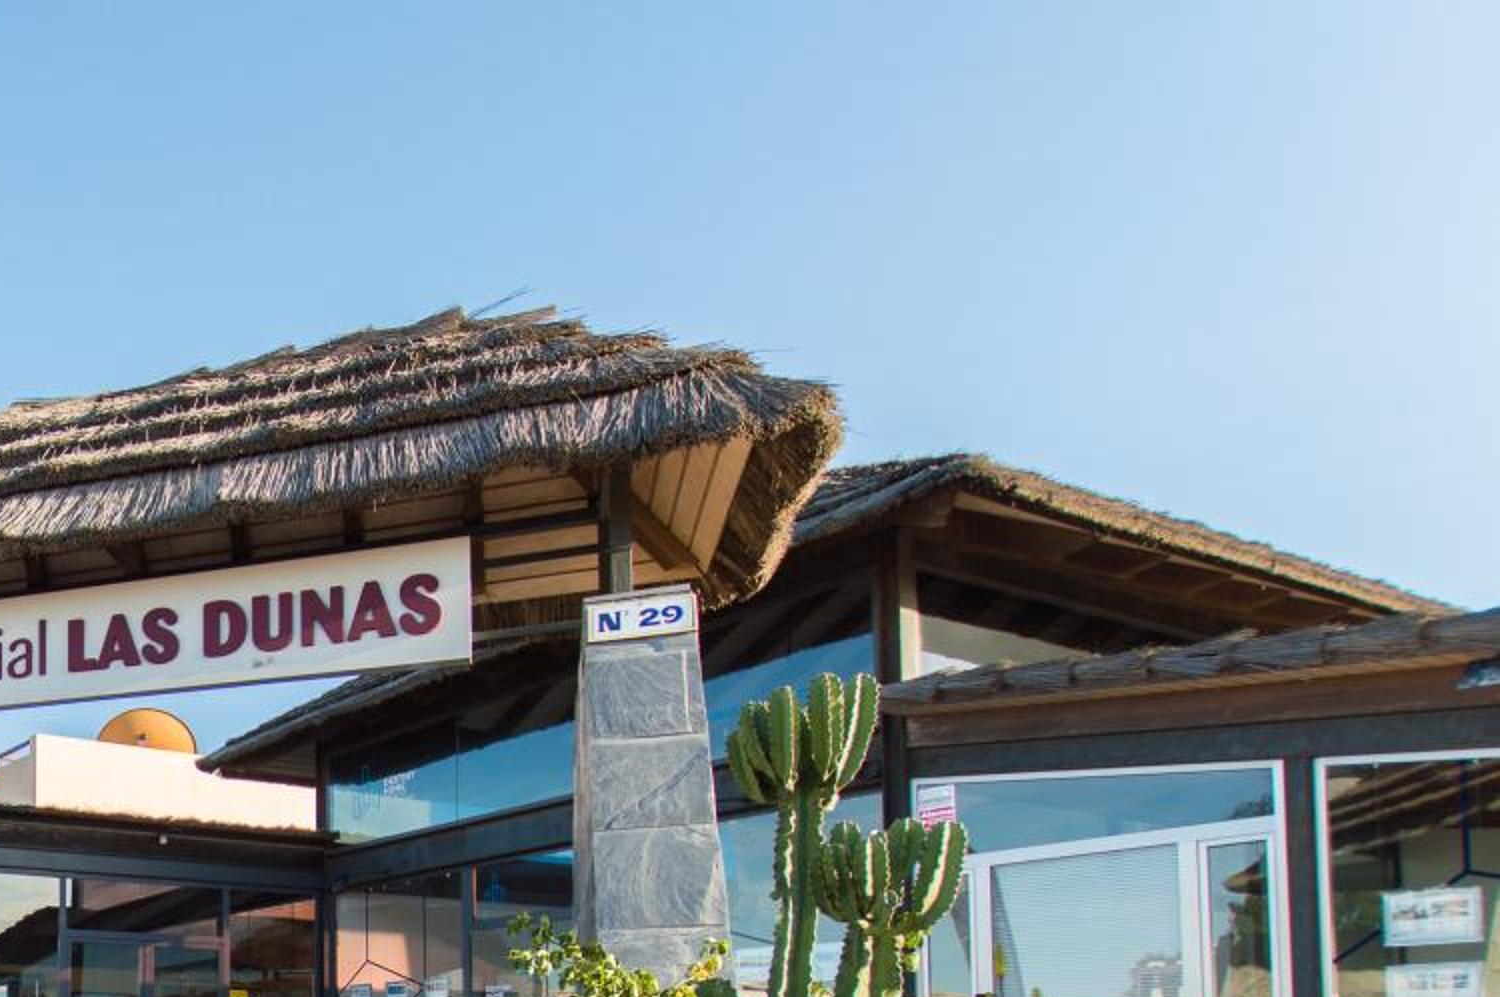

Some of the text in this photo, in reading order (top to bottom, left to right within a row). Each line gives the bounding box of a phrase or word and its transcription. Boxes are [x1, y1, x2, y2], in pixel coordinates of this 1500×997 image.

[68, 607, 179, 672] LAS
[203, 573, 441, 658] DUNAS
[639, 605, 682, 627] 29
